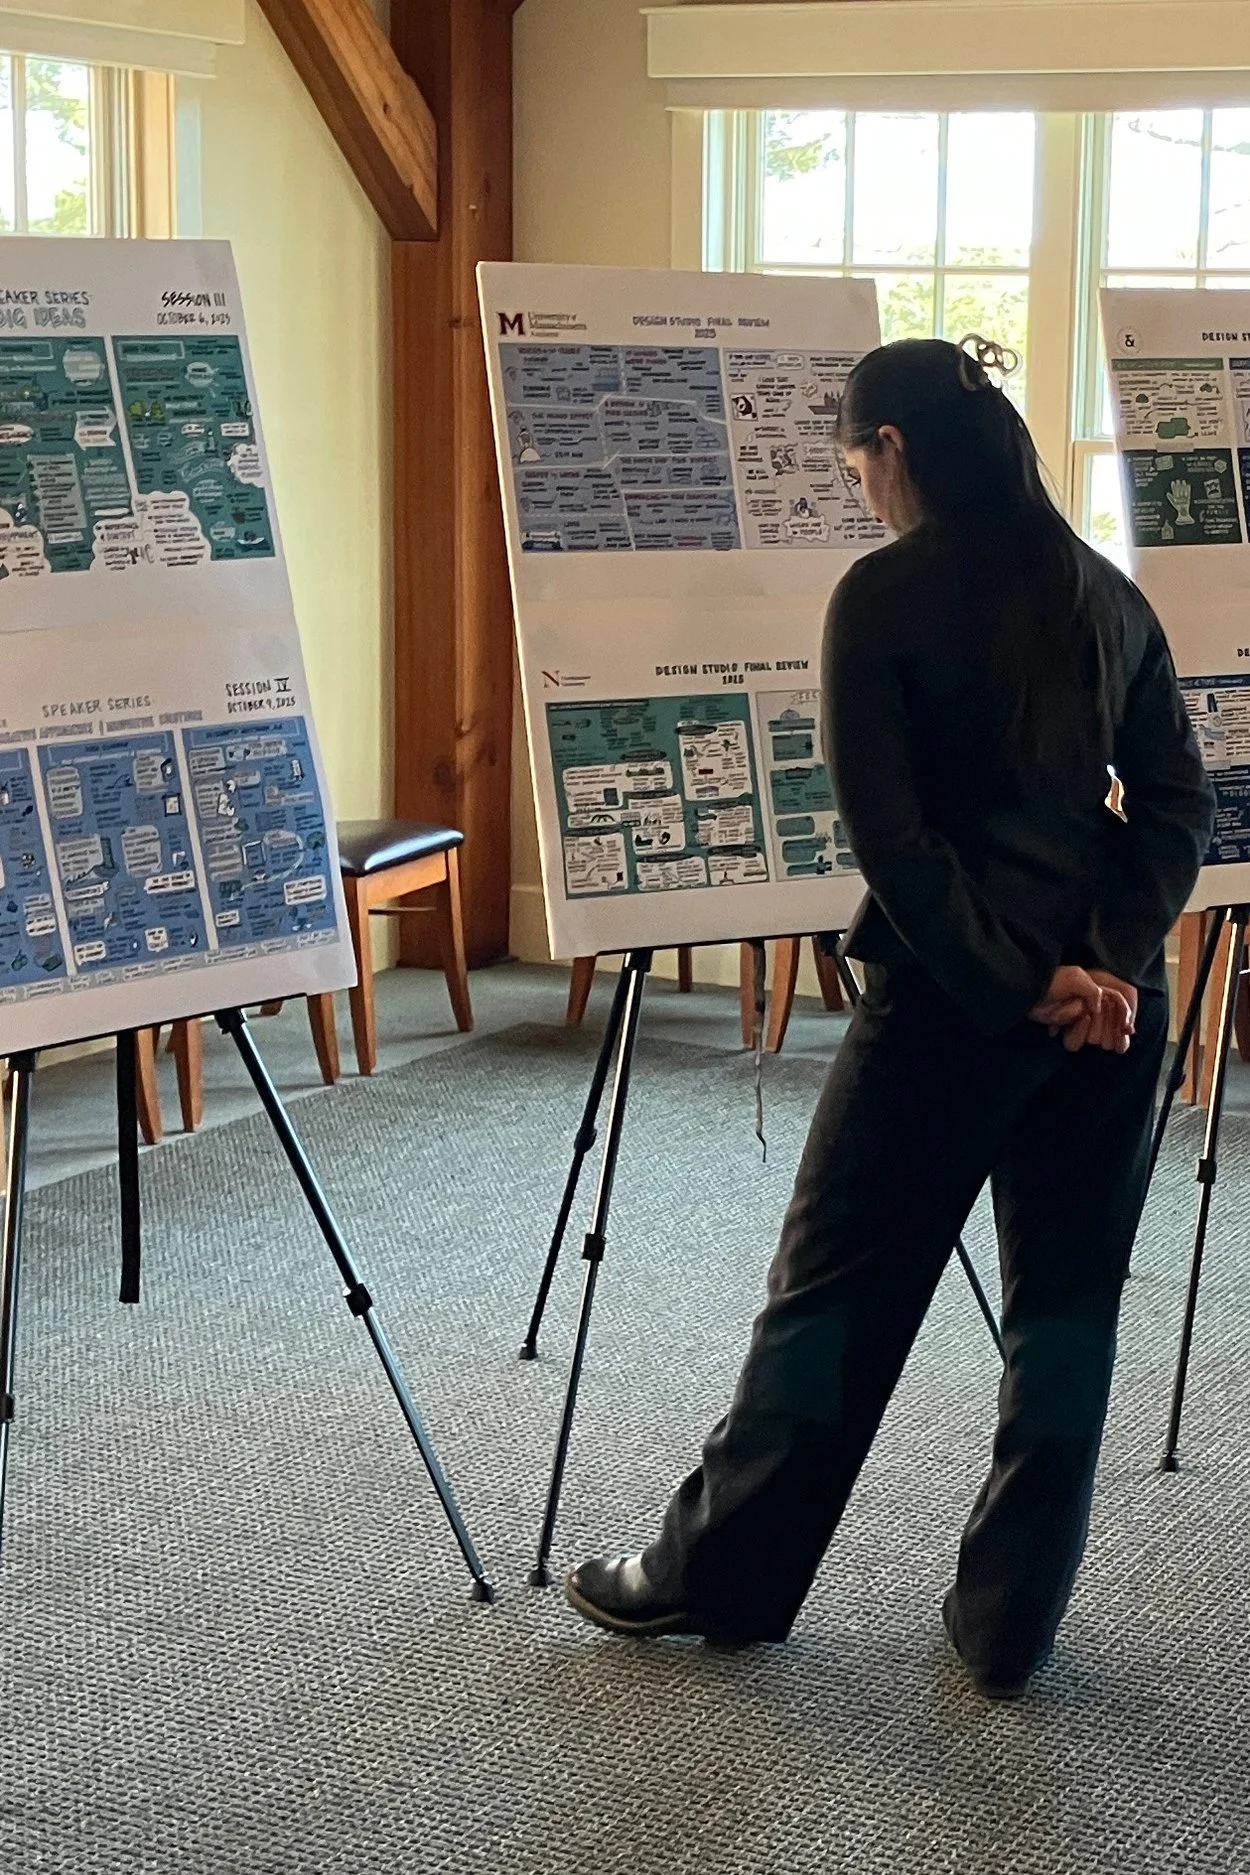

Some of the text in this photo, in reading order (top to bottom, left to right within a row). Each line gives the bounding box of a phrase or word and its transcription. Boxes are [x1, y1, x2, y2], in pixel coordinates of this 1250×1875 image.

[45, 290, 89, 305] SERIES
[161, 291, 211, 307] SESSION
[33, 306, 87, 328] IDEAS
[156, 311, 195, 325] OCTOBER
[496, 312, 526, 336] M
[632, 316, 667, 326] DESIGN
[669, 317, 701, 326] STUDIO
[707, 316, 733, 326] FINAL
[1201, 332, 1238, 341] DESIGN
[655, 660, 809, 676] DESIGN STUDIO FINAL REVIEW
[225, 677, 292, 697] SESSION IV
[42, 695, 152, 718] SPEAKER SERIES
[227, 698, 265, 714] OCTOBER
[276, 696, 296, 709] 2025
